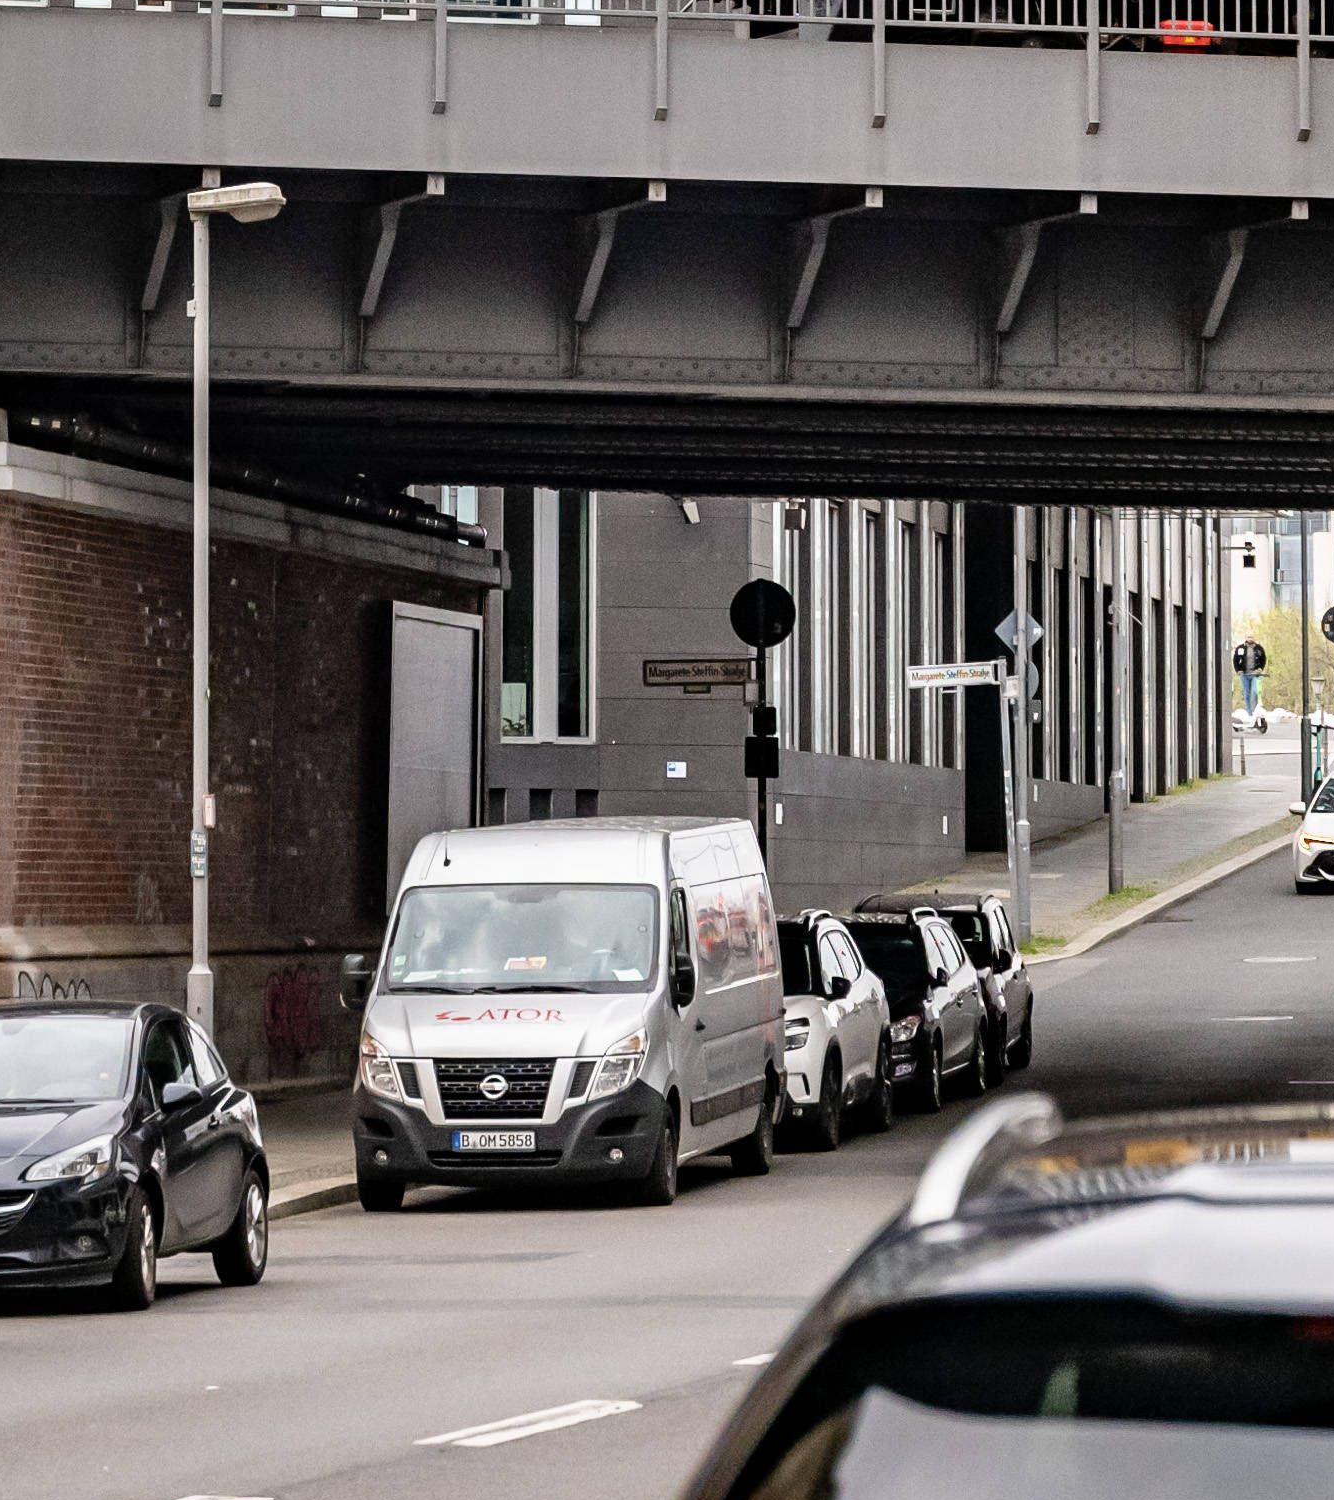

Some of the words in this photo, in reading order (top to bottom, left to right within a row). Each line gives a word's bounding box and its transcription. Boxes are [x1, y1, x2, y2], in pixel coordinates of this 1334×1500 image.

[477, 1008, 563, 1022] ATOR
[462, 1135, 470, 1147] B
[479, 1134, 497, 1147] OM
[499, 1134, 533, 1147] 5858
